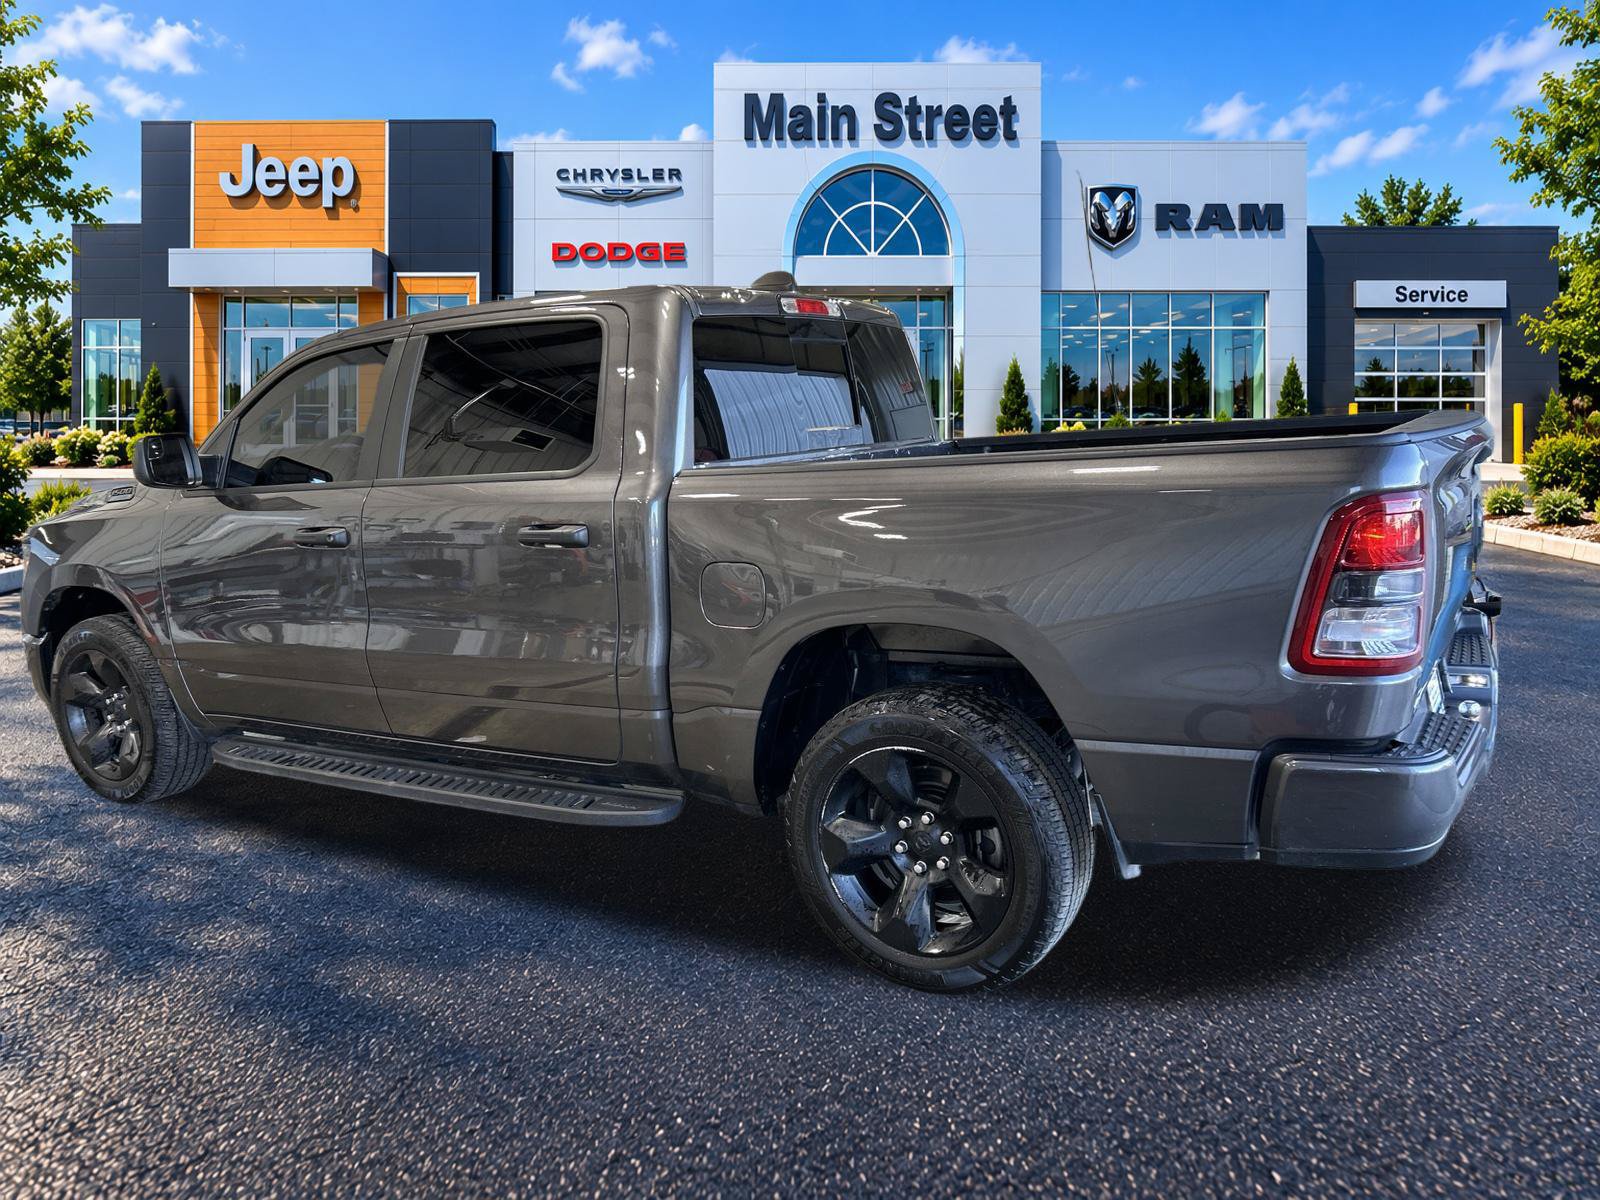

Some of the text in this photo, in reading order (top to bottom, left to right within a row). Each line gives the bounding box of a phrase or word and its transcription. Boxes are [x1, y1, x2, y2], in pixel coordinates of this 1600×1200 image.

[743, 91, 1018, 142] Main Street
[218, 143, 356, 209] Jeep
[556, 167, 682, 182] CHRYSLER
[1155, 203, 1284, 232] RAM
[551, 242, 686, 262] DODGE
[1395, 285, 1469, 303] Service
